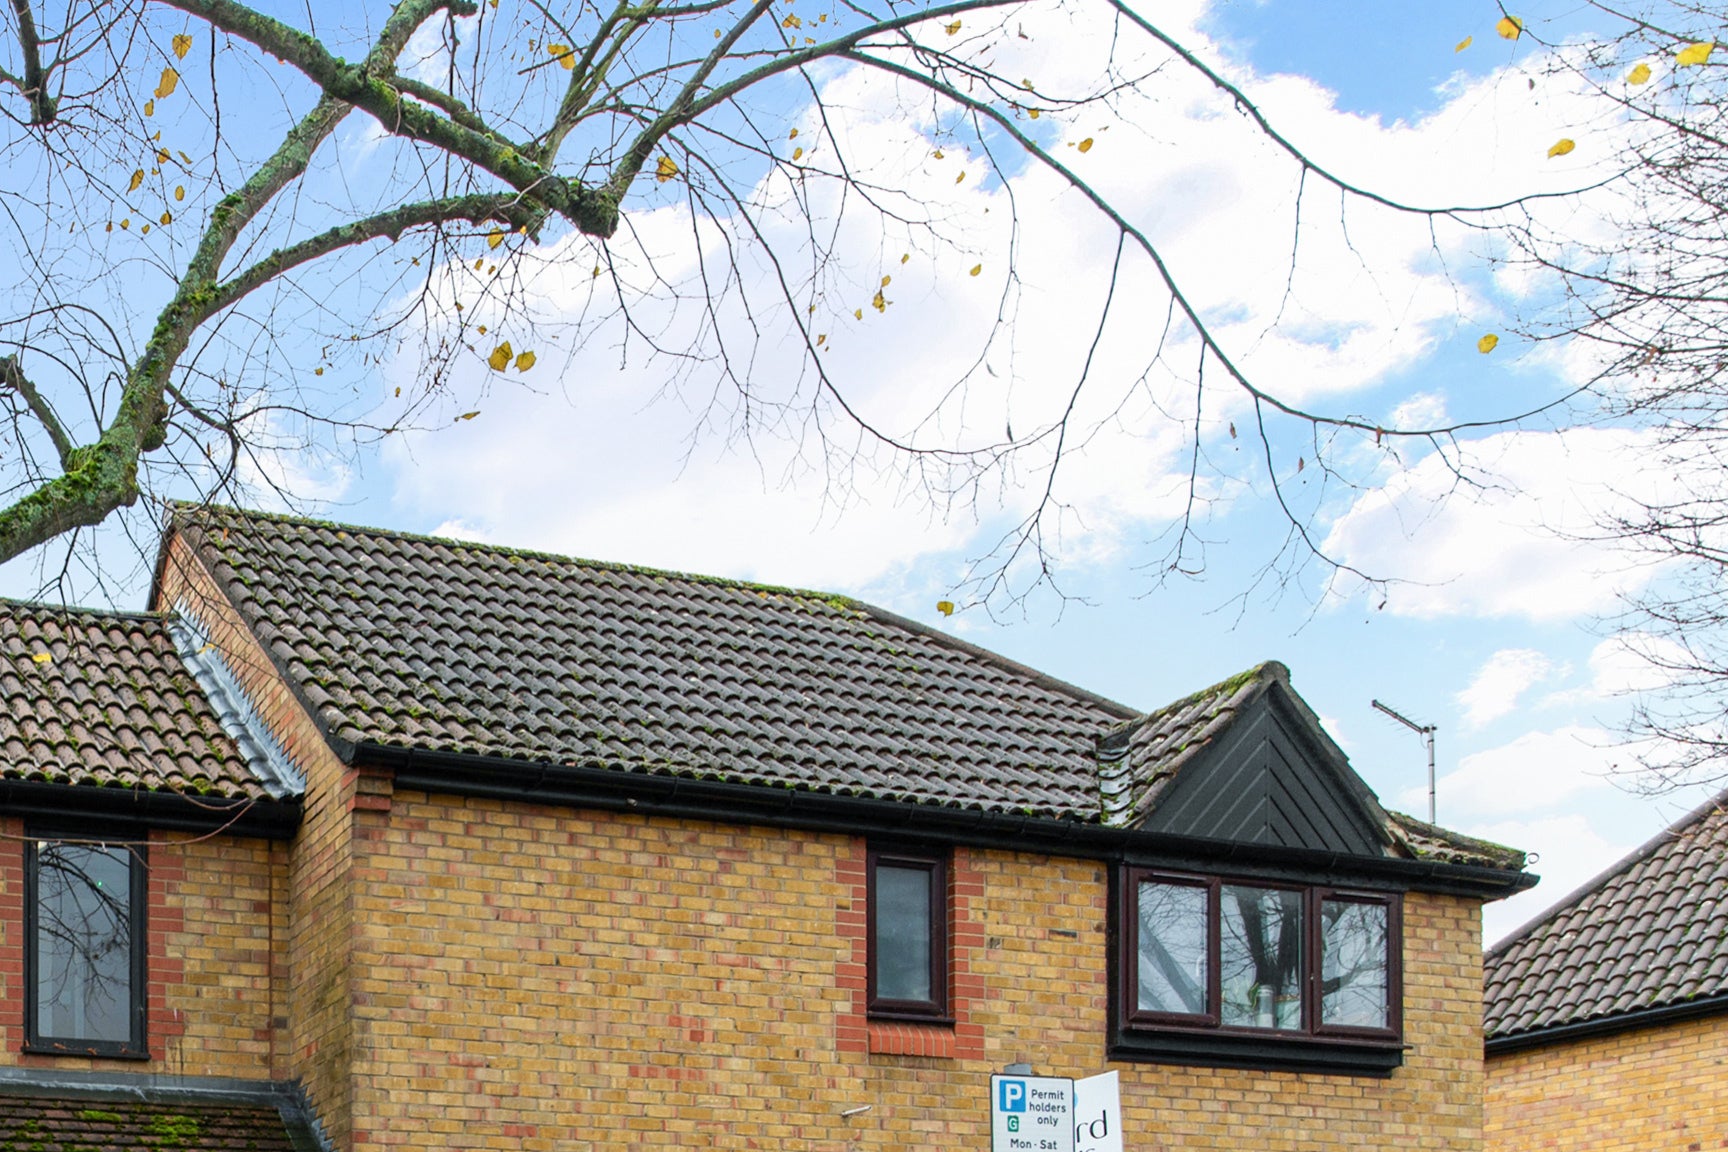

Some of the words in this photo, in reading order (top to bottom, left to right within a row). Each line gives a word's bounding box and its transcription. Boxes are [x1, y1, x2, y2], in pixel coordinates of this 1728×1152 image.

[1005, 1083, 1023, 1110] P
[1031, 1089, 1065, 1100] Permit
[1029, 1102, 1066, 1113] holders
[1008, 1117, 1018, 1130] G
[1037, 1116, 1059, 1127] only
[1010, 1138, 1032, 1149] Mon
[1039, 1139, 1058, 1150] Sat
